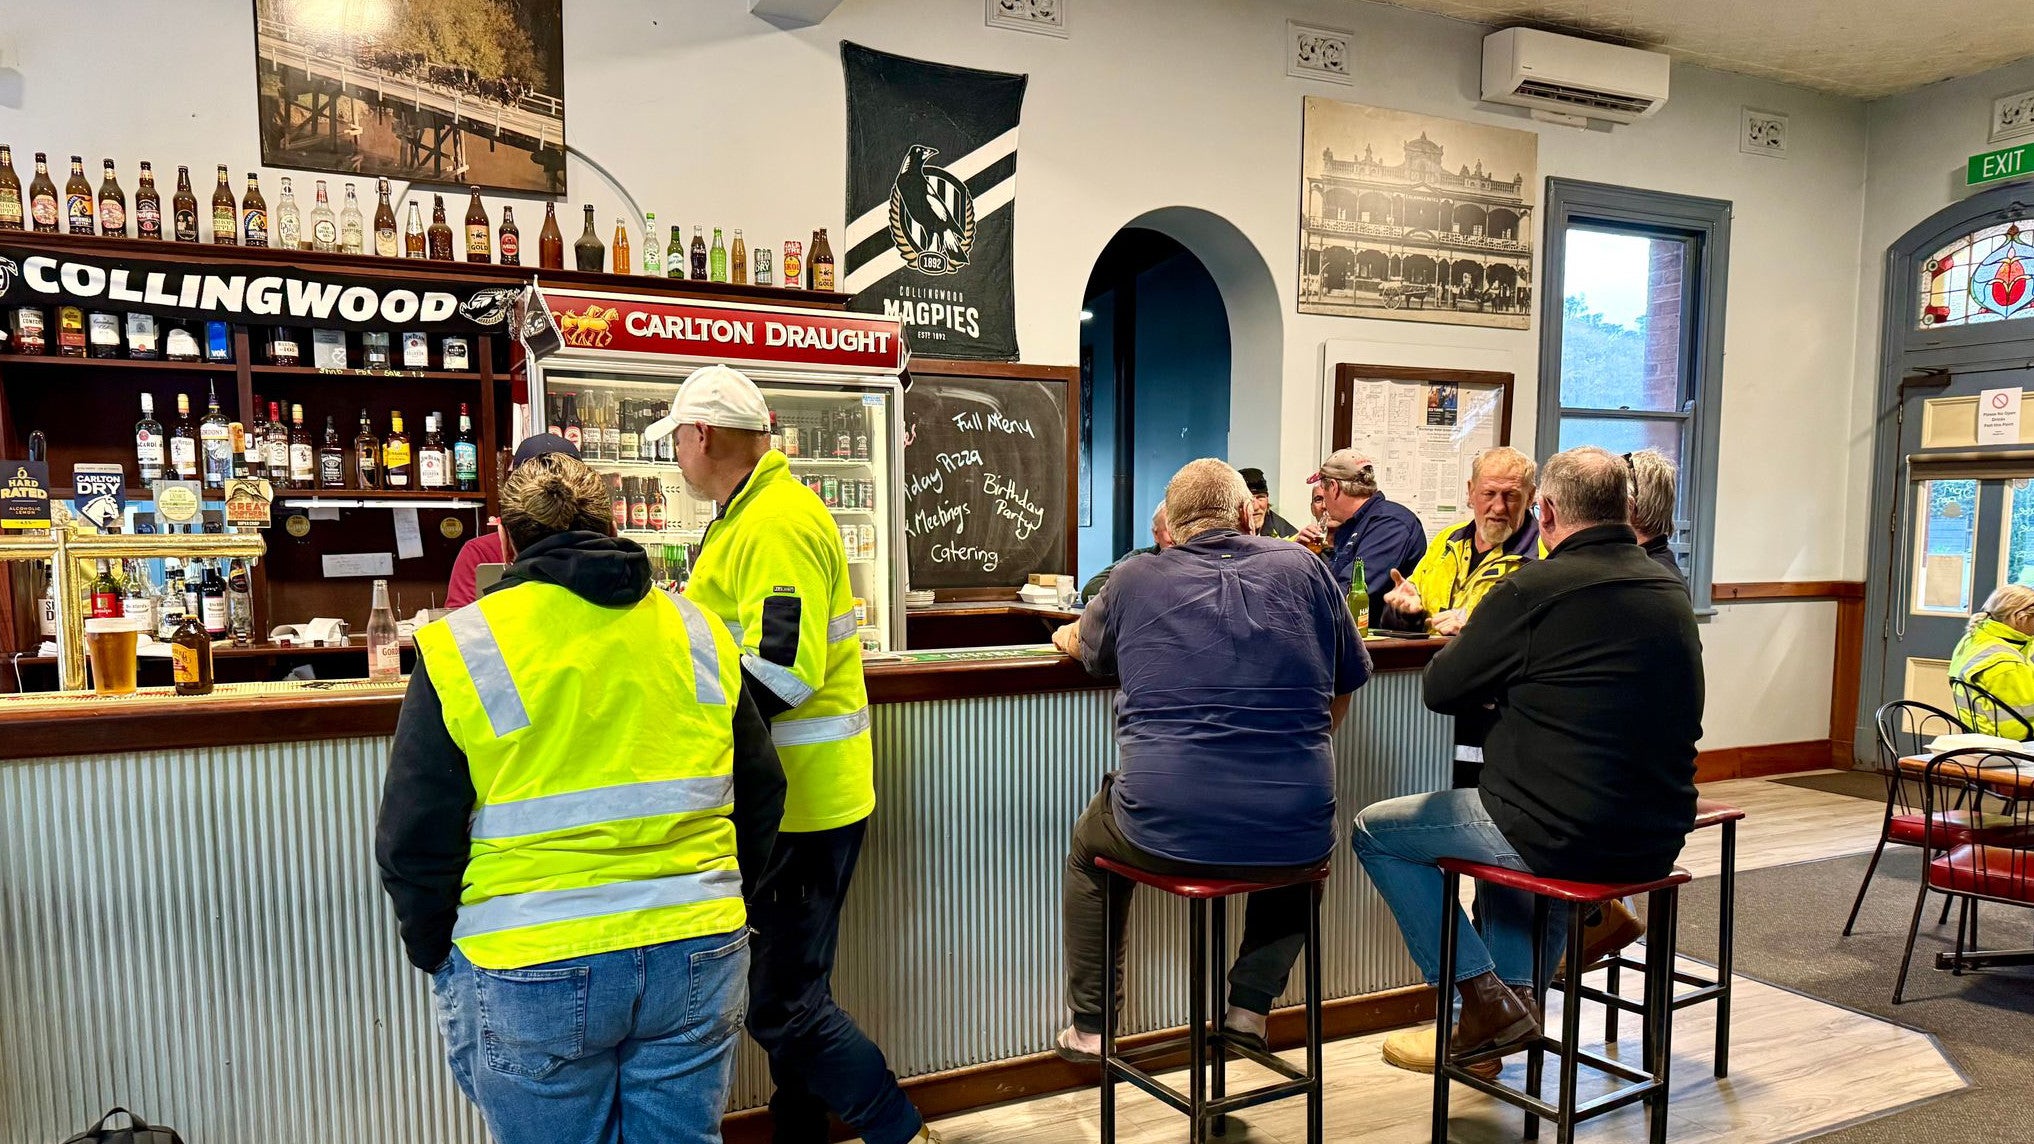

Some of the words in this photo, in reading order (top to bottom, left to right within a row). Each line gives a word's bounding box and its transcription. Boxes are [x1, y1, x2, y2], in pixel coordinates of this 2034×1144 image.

[1983, 149, 2025, 178] EXIT
[923, 256, 942, 269] 1892
[23, 256, 459, 323] COLLINGWOOD
[899, 286, 964, 303] COLLINGWOOD
[883, 298, 980, 339] MAGPIES
[625, 311, 754, 345] CARLTON
[765, 321, 892, 354] DRAUGHT
[952, 411, 984, 433] Full
[935, 449, 984, 474] Pizza
[8, 479, 39, 487] HARD
[76, 475, 121, 483] CARLTON
[77, 483, 120, 495] DRY
[0, 487, 48, 499] RATED
[983, 472, 1045, 531] Birthday
[228, 502, 268, 511] GREAT
[995, 499, 1033, 540] Party
[931, 540, 998, 572] Catering
